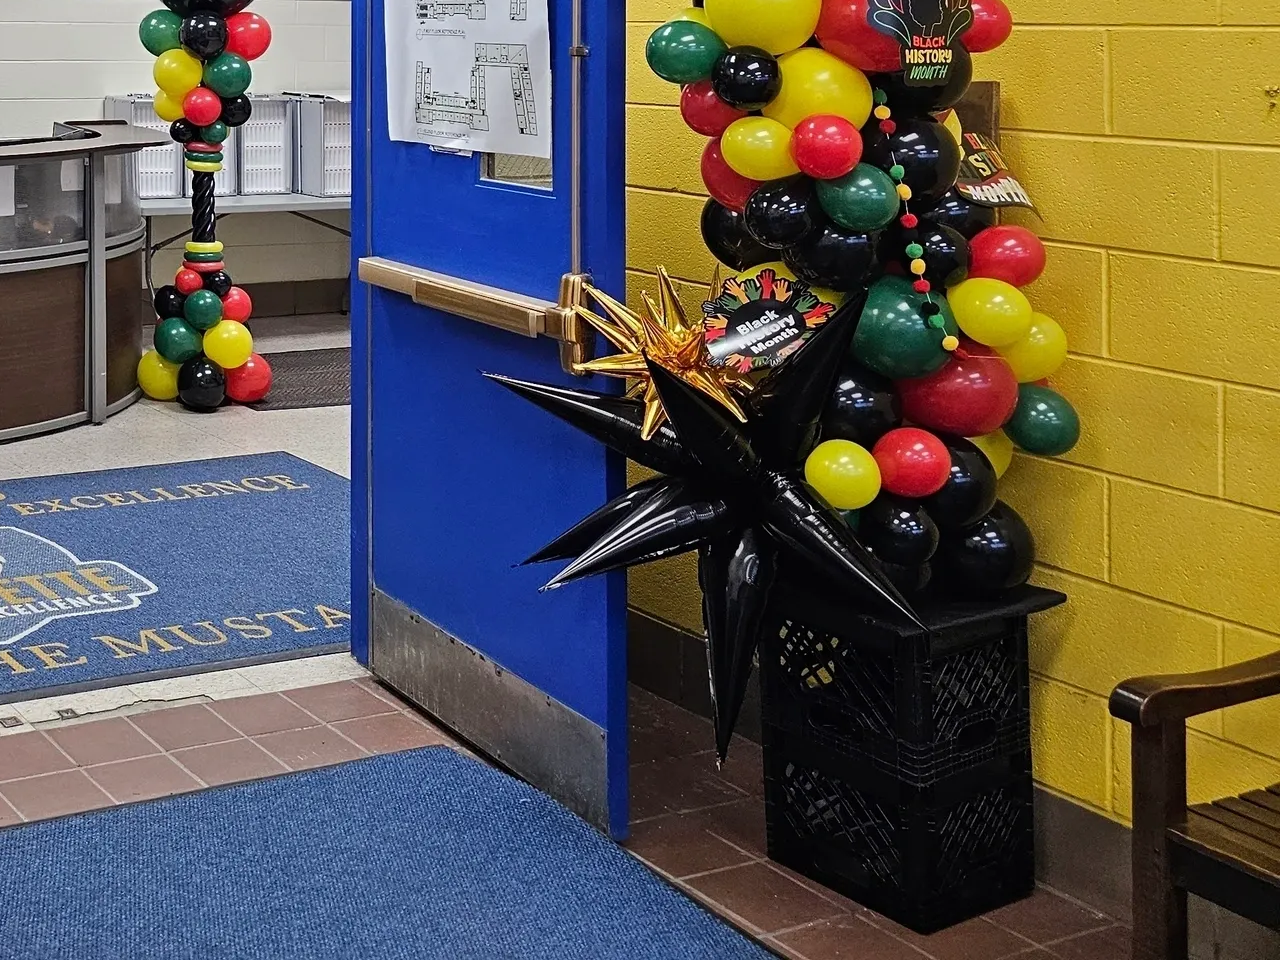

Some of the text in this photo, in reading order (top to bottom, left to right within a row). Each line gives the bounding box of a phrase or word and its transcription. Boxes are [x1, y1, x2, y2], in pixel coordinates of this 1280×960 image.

[912, 36, 946, 48] BLACK
[905, 48, 953, 64] HISTORY
[735, 309, 780, 336] Black
[750, 327, 799, 355] Month
[14, 474, 312, 517] EXCELLENCE
